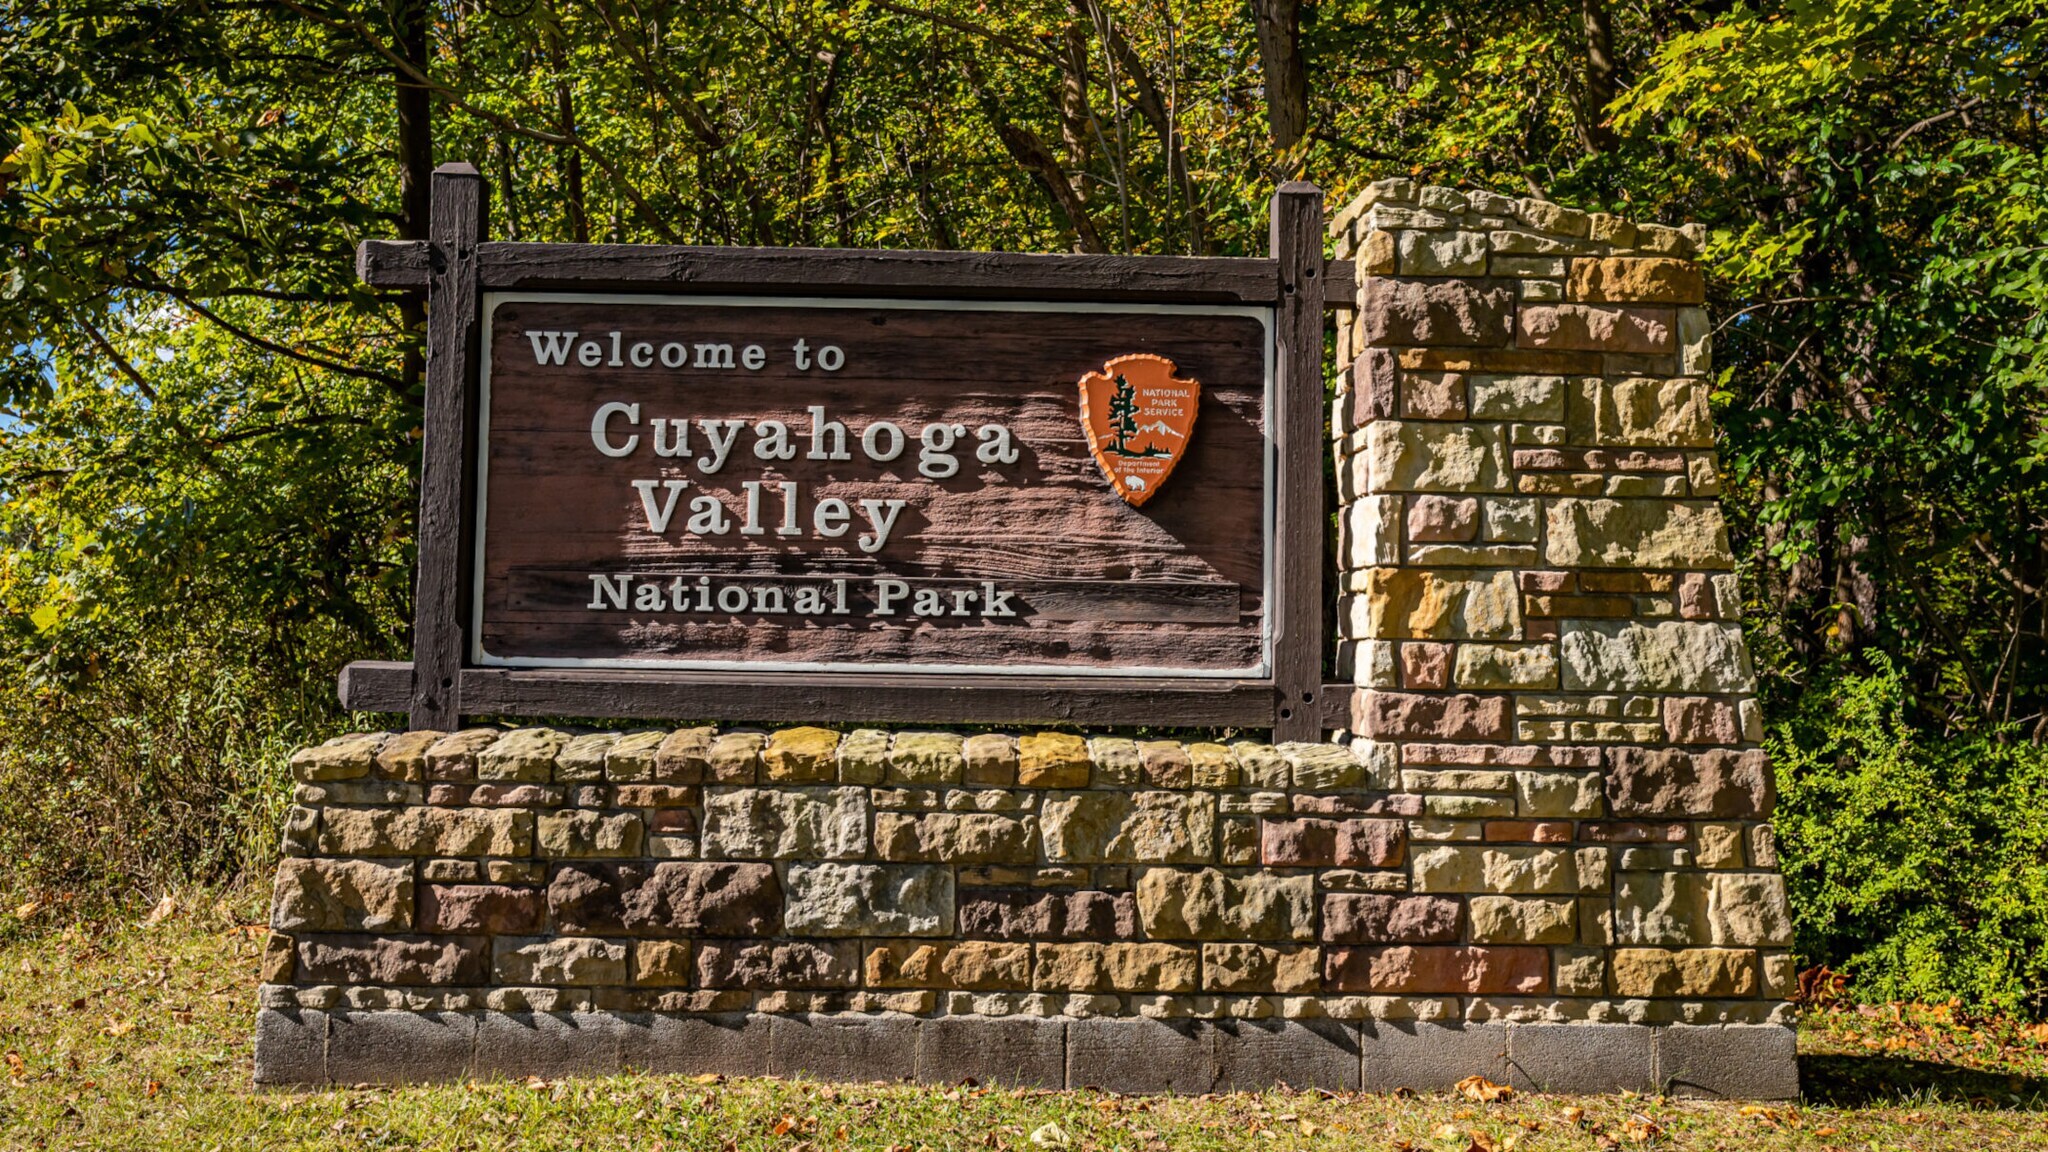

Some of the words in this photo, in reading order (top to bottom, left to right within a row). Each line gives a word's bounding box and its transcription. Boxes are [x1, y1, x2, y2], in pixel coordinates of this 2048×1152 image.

[526, 331, 766, 370] Welcome
[793, 338, 846, 371] to
[1142, 388, 1190, 398] NATIONAL
[1151, 399, 1178, 407] PARK
[1143, 408, 1184, 417] SERVICE
[590, 401, 1020, 478] Cuyahoga
[1118, 460, 1160, 468] Department
[631, 479, 908, 553] Valley
[586, 574, 853, 615] National
[872, 579, 1017, 617] Park
